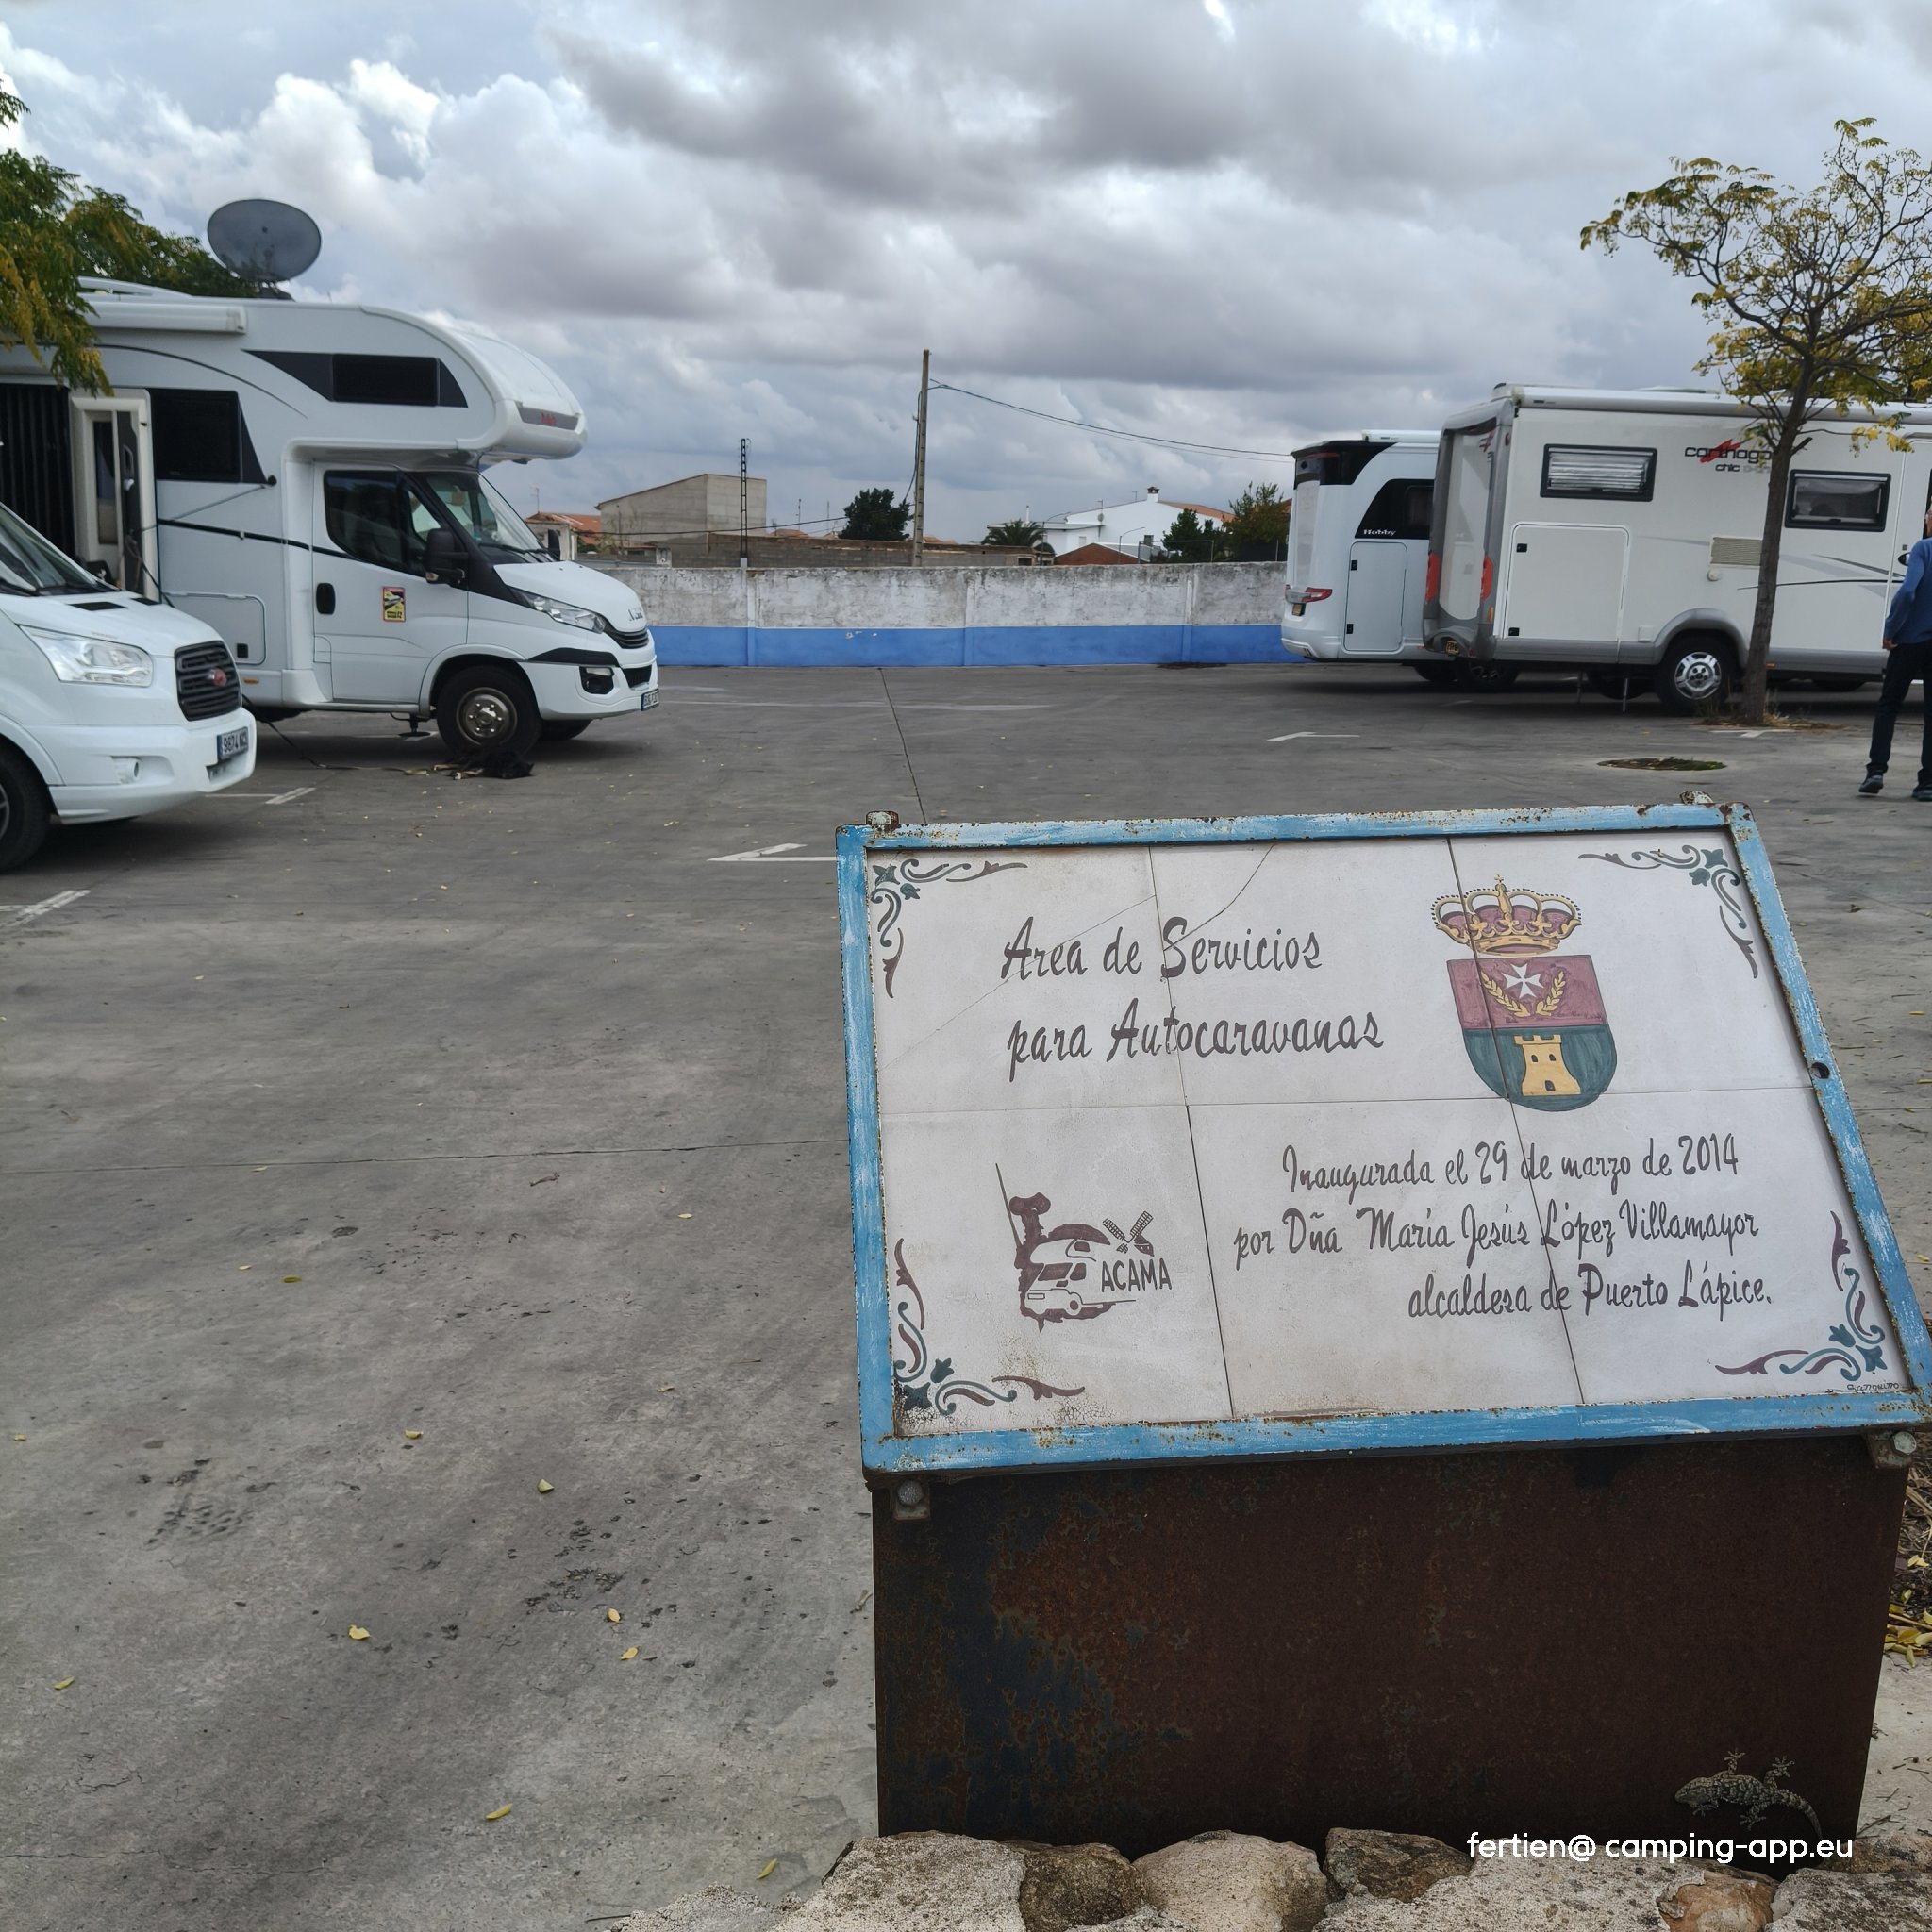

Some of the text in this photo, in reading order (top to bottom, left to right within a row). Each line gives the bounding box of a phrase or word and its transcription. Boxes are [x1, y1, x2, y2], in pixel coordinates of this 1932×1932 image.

[1715, 463, 1740, 473] chic
[1363, 528, 1396, 537] Hobby
[1001, 916, 1323, 980] Area de Servicios
[1007, 997, 1384, 1083] para Autocaravanas
[1282, 1133, 1739, 1204] Inaugurada el 29 de marzo de 2014
[1233, 1199, 1759, 1271] por Dña María Jesús López Villamayor
[1102, 1257, 1173, 1292] ACAMA
[1408, 1260, 1772, 1321] alcaldesa de Puerto Lápice.
